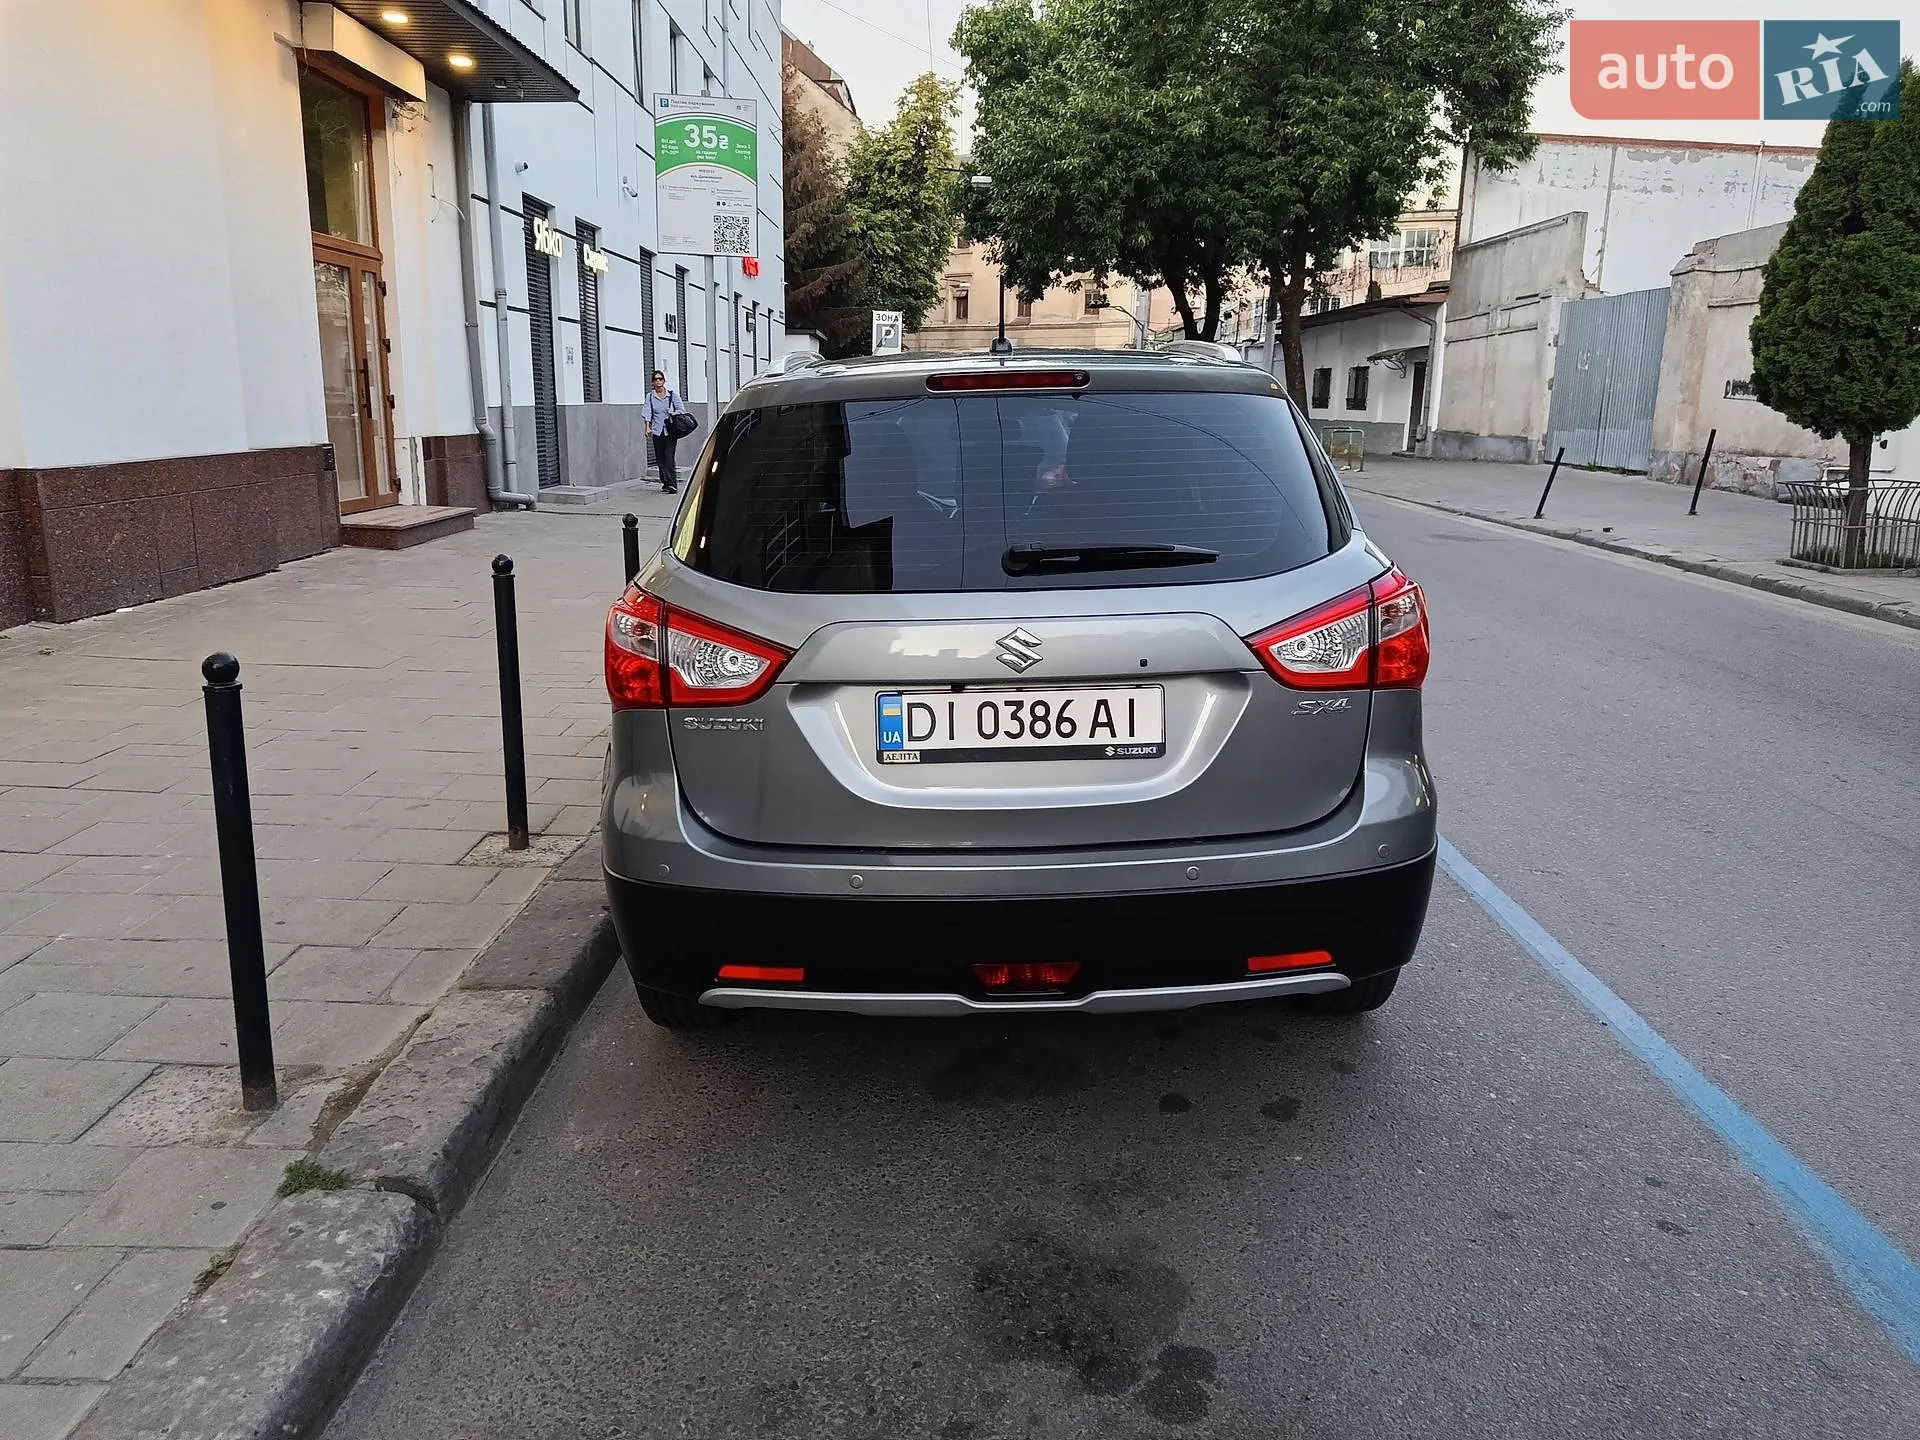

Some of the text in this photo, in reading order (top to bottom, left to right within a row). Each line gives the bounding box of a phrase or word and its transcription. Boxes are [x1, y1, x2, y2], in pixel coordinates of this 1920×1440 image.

[534, 217, 562, 258] Ябко
[875, 313, 899, 322] ЗОНА
[1291, 697, 1353, 715] SX4
[683, 716, 765, 731] SUZUKI
[906, 698, 1135, 742] DI 0386 AI
[883, 730, 901, 744] UA
[1117, 746, 1157, 755] SUZUKI
